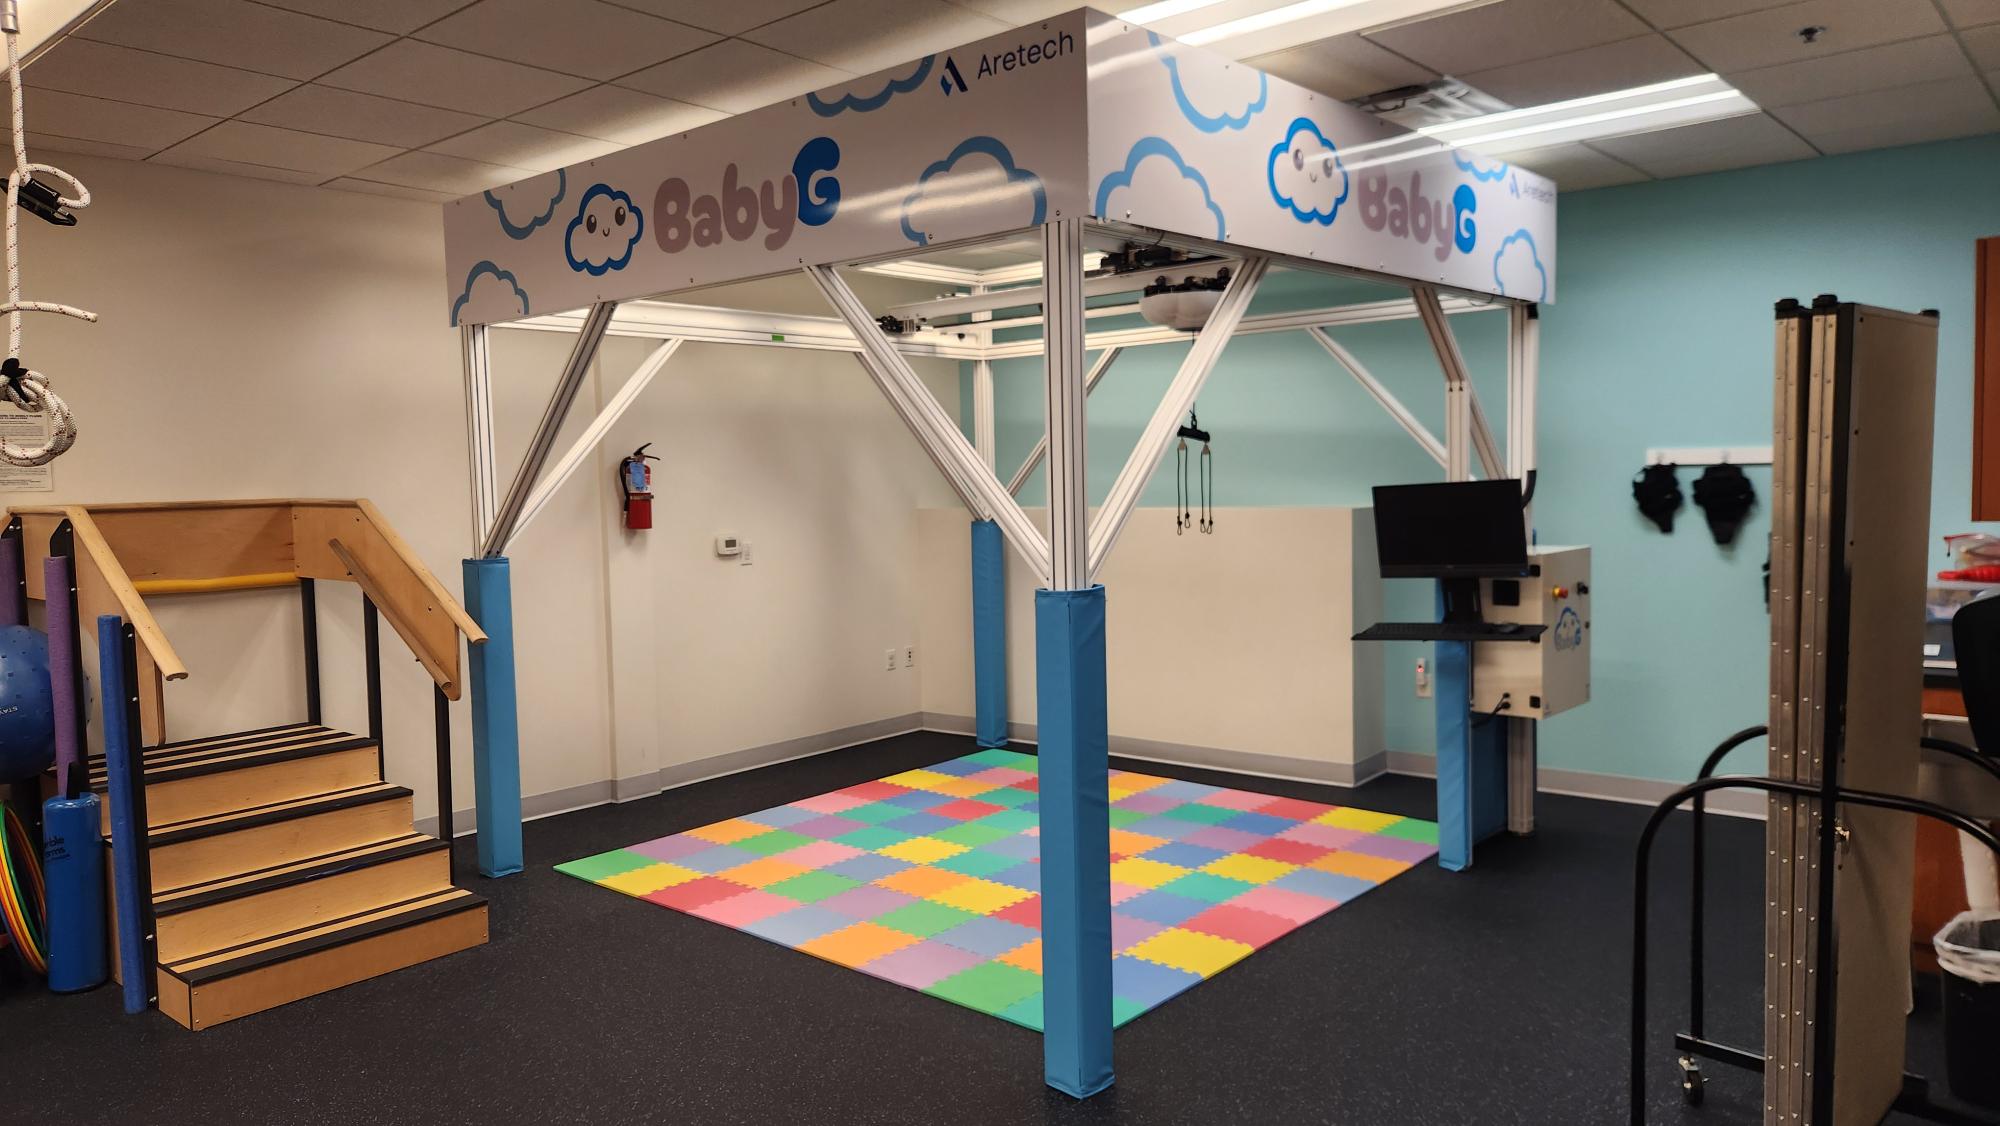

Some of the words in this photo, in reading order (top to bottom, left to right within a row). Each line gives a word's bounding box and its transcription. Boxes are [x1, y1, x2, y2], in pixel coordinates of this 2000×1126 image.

[977, 31, 1074, 80] Aretech
[653, 136, 842, 254] BabyG
[1357, 153, 1477, 263] BabyG
